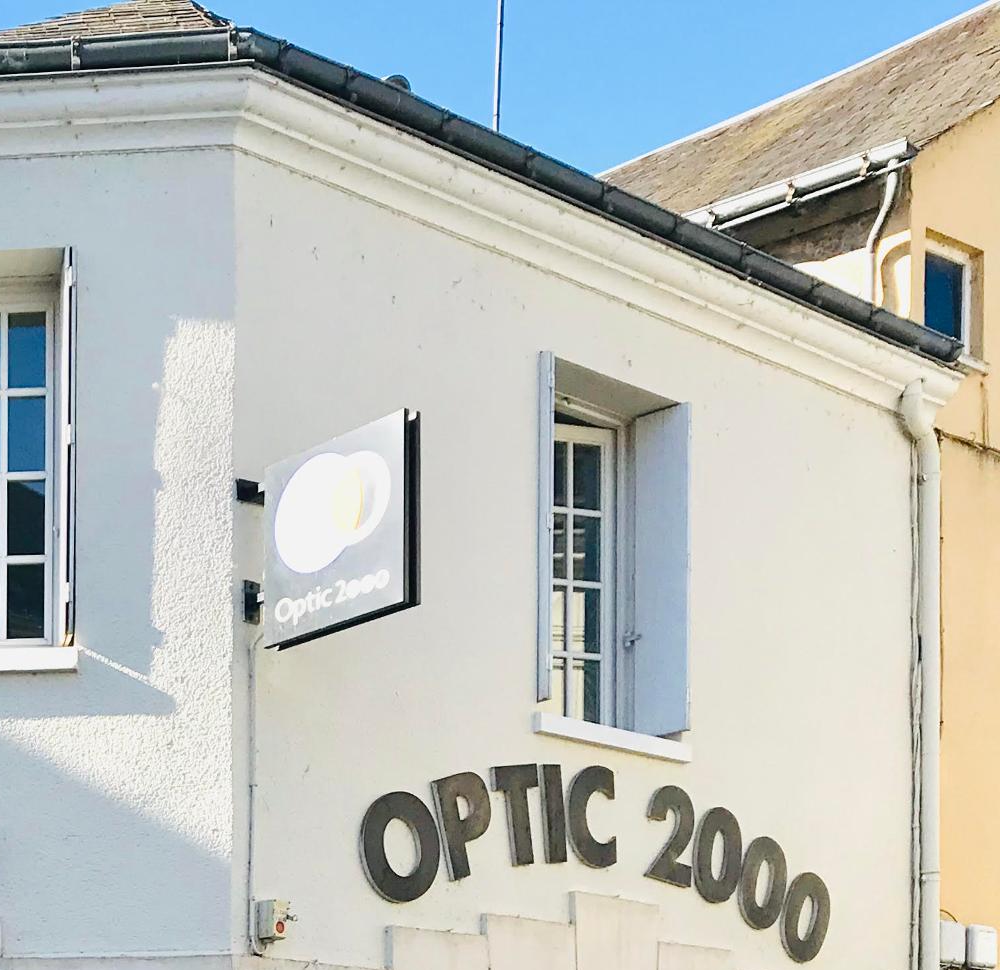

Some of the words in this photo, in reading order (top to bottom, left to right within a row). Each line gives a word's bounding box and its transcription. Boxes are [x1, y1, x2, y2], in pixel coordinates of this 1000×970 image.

[275, 586, 333, 626] Optic
[334, 568, 391, 604] 2000
[359, 763, 618, 904] OPTIC
[644, 784, 831, 964] 2000
